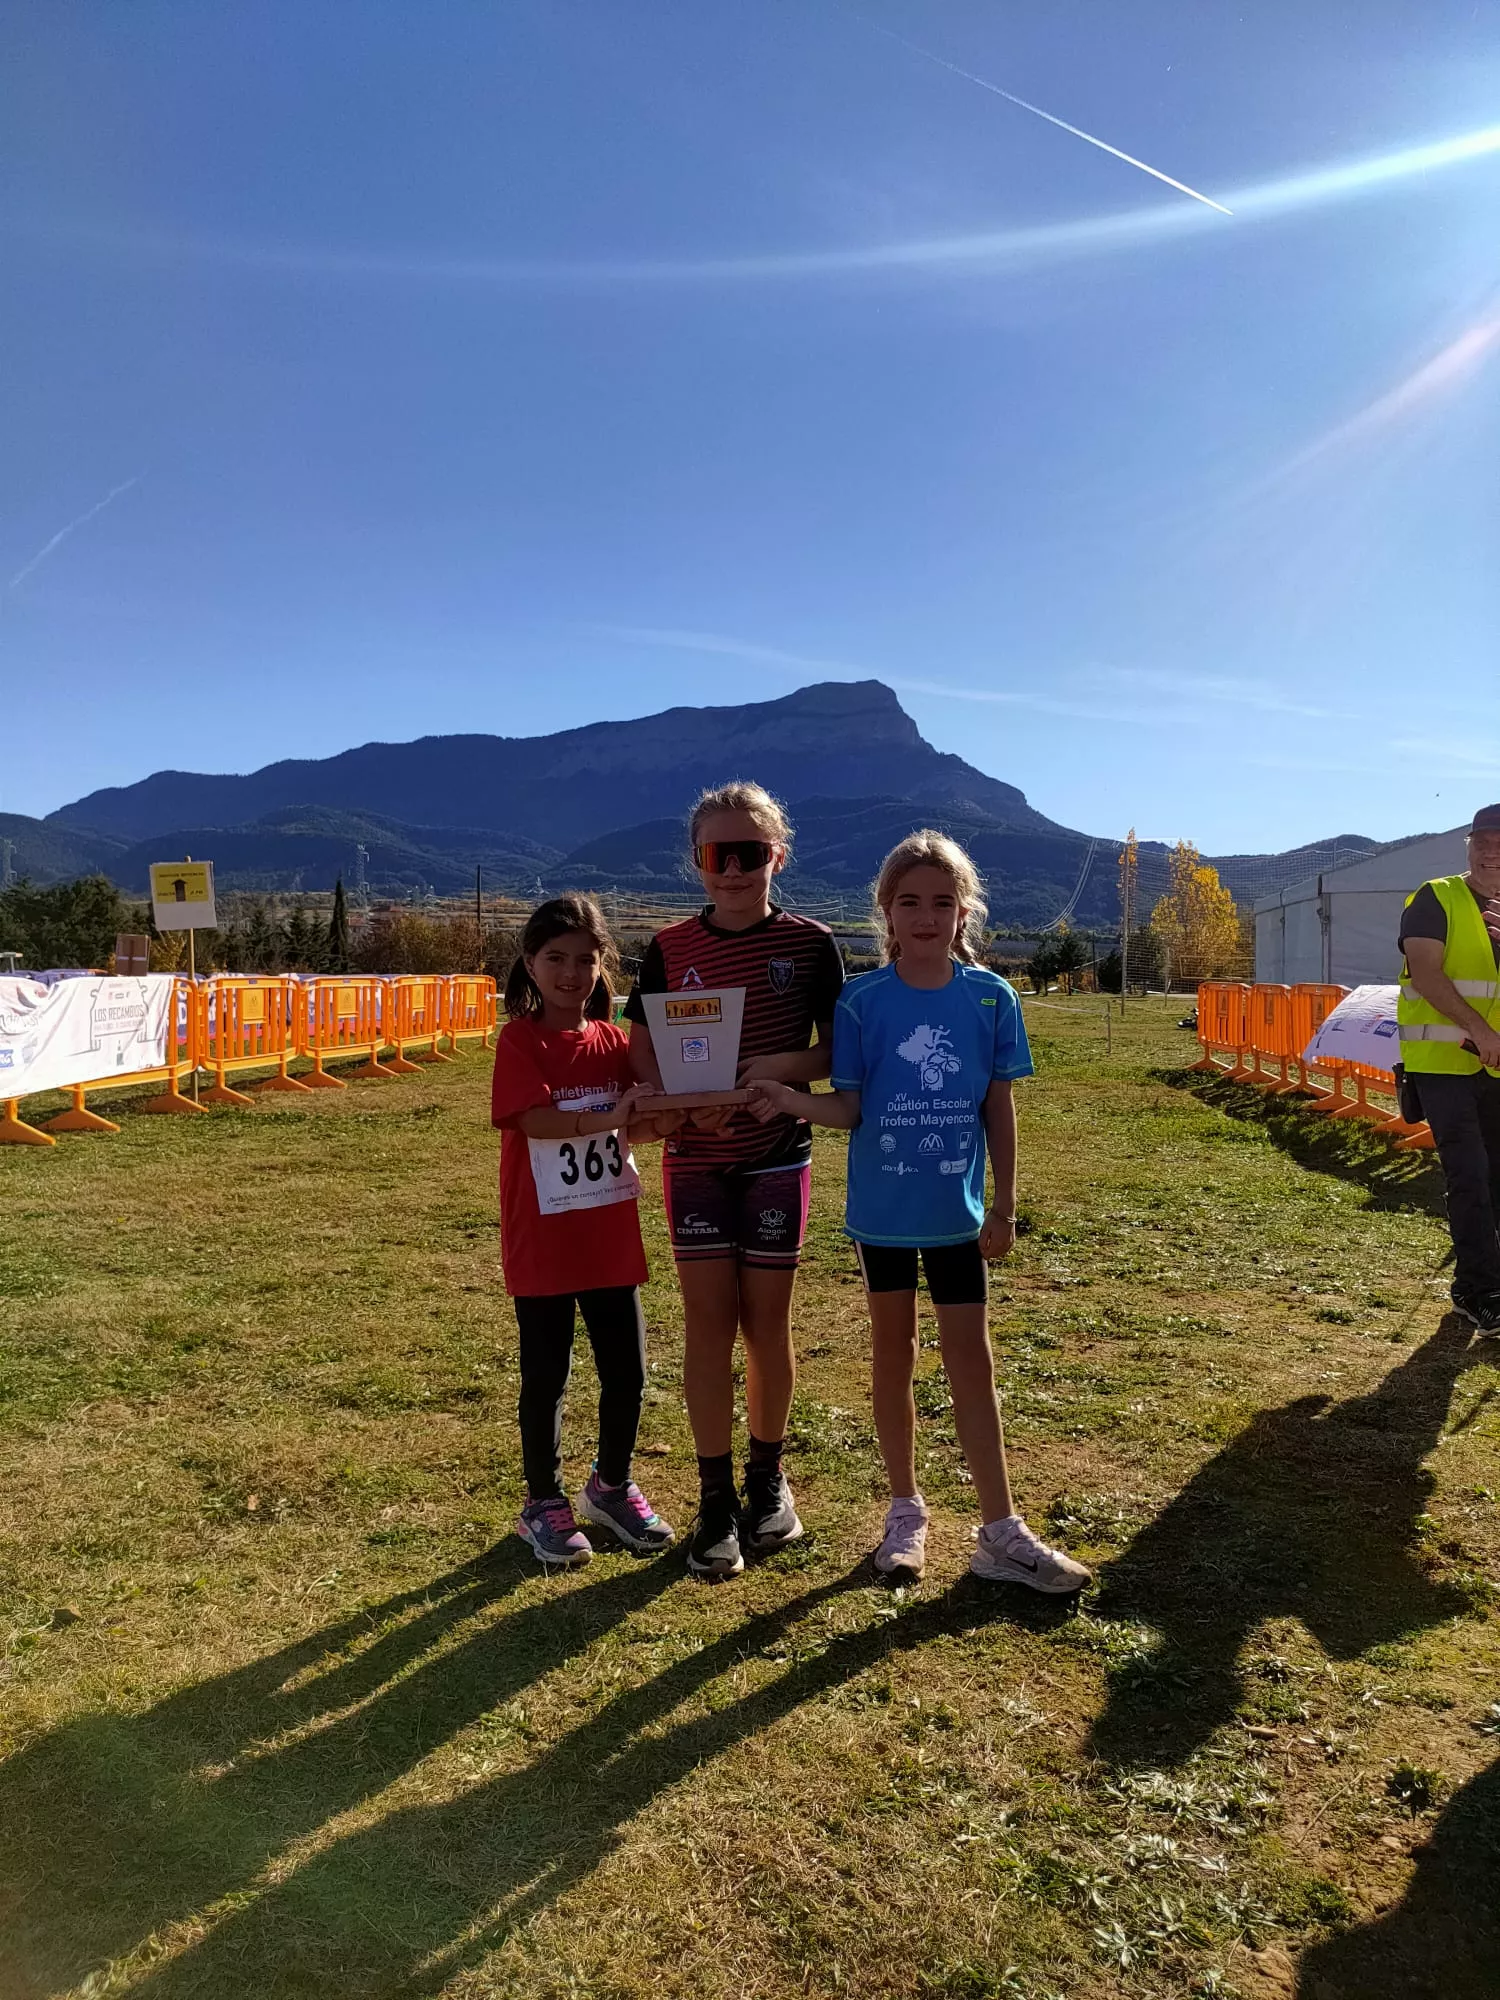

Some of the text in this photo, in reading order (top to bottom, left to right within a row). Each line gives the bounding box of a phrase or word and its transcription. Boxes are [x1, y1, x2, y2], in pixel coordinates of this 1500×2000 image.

[94, 1007, 107, 1022] LOS
[895, 1092, 907, 1102] XV
[887, 1097, 972, 1112] Duatlón Escolar
[879, 1114, 975, 1127] Trofeo Mayencos
[559, 1134, 623, 1185] 363
[676, 1227, 720, 1235] CINTASA
